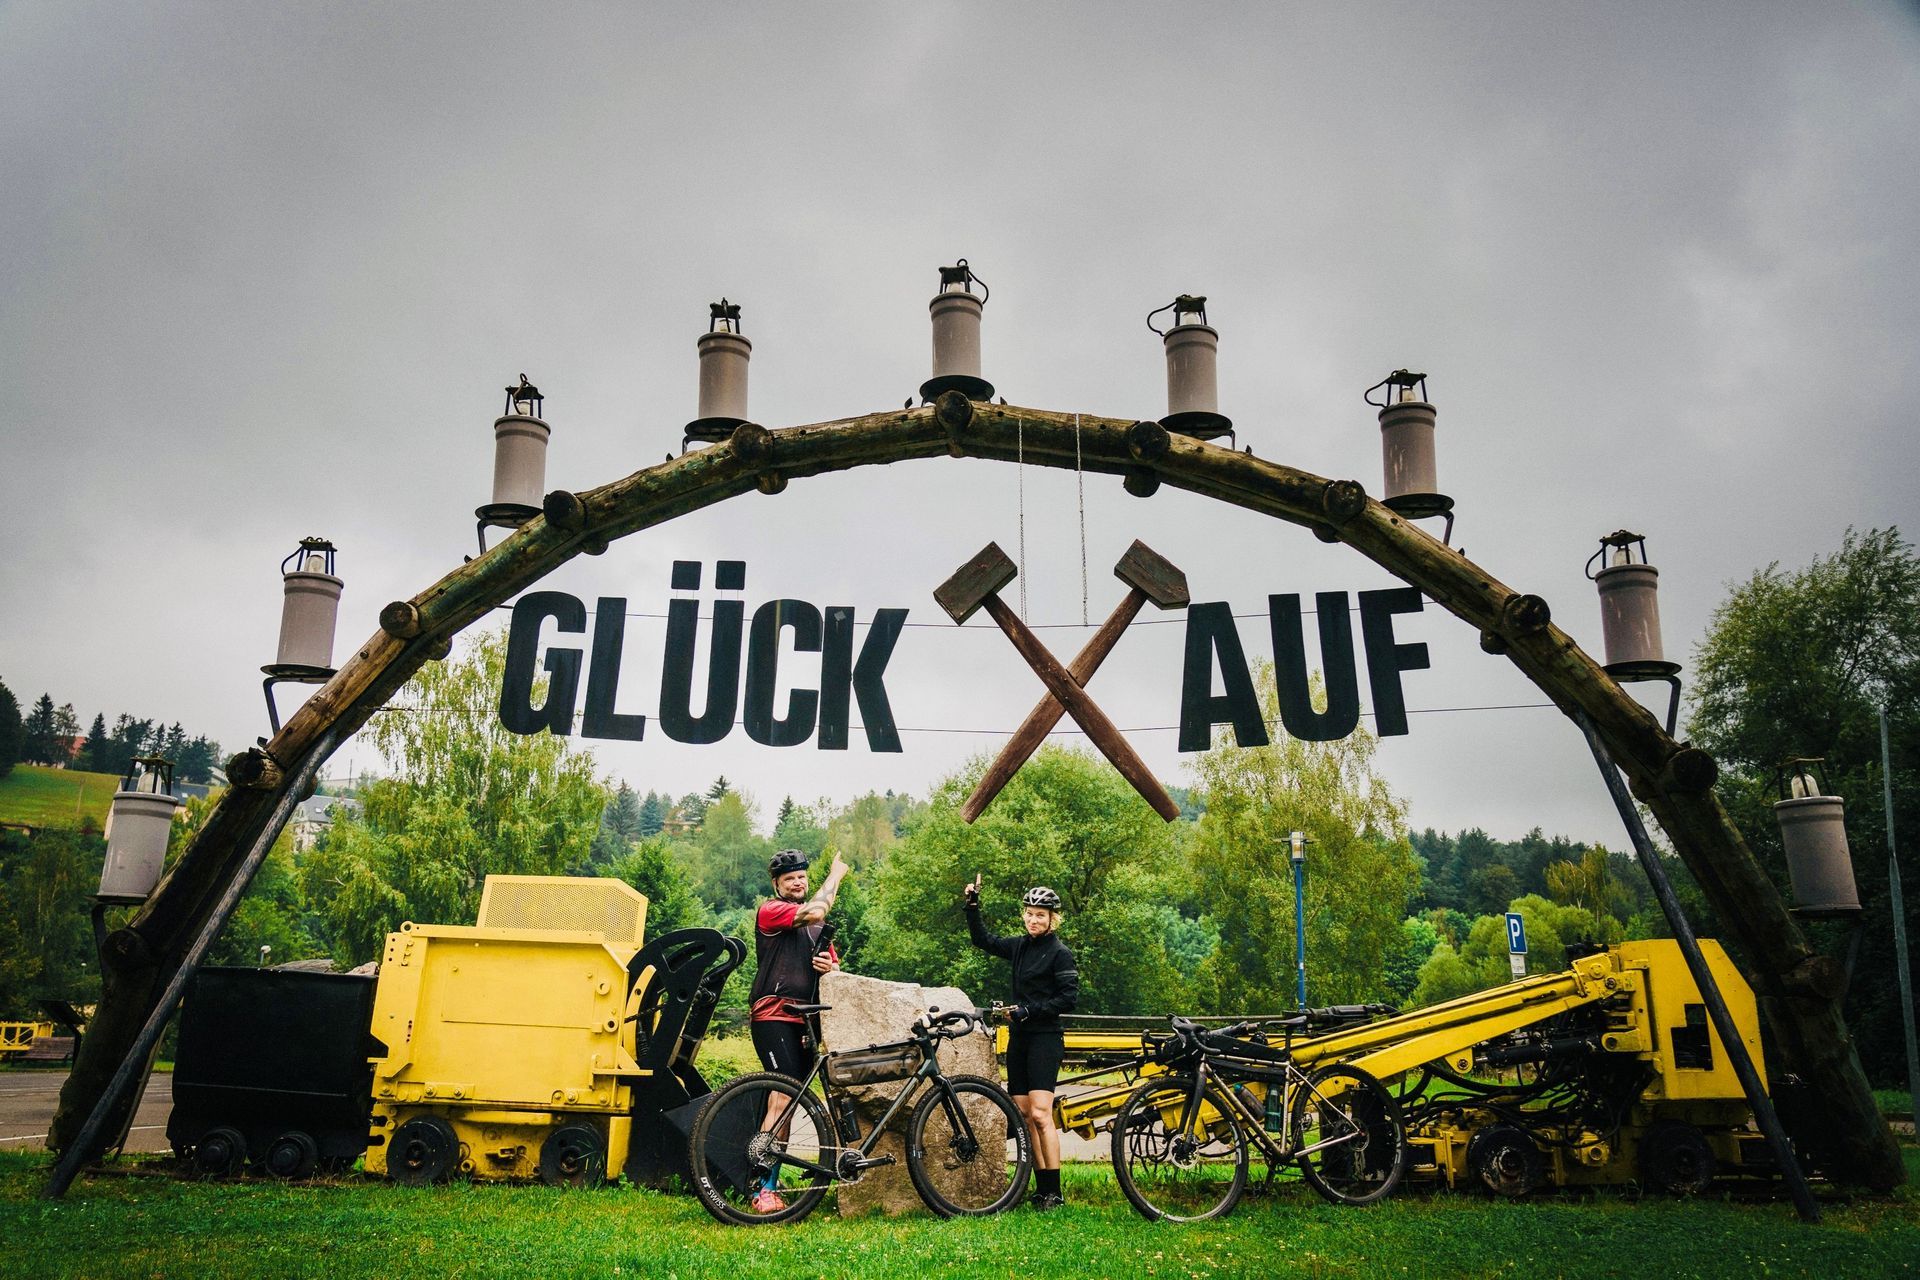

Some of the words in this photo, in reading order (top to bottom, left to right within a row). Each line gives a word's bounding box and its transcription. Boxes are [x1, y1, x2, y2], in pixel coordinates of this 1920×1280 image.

[499, 560, 910, 753] GLÜCK
[1178, 586, 1431, 752] AUF
[1510, 918, 1520, 948] P
[1017, 1126, 1026, 1149] SWISS
[1021, 1149, 1027, 1162] DT
[700, 1176, 711, 1188] DT
[707, 1189, 726, 1209] SWISS
